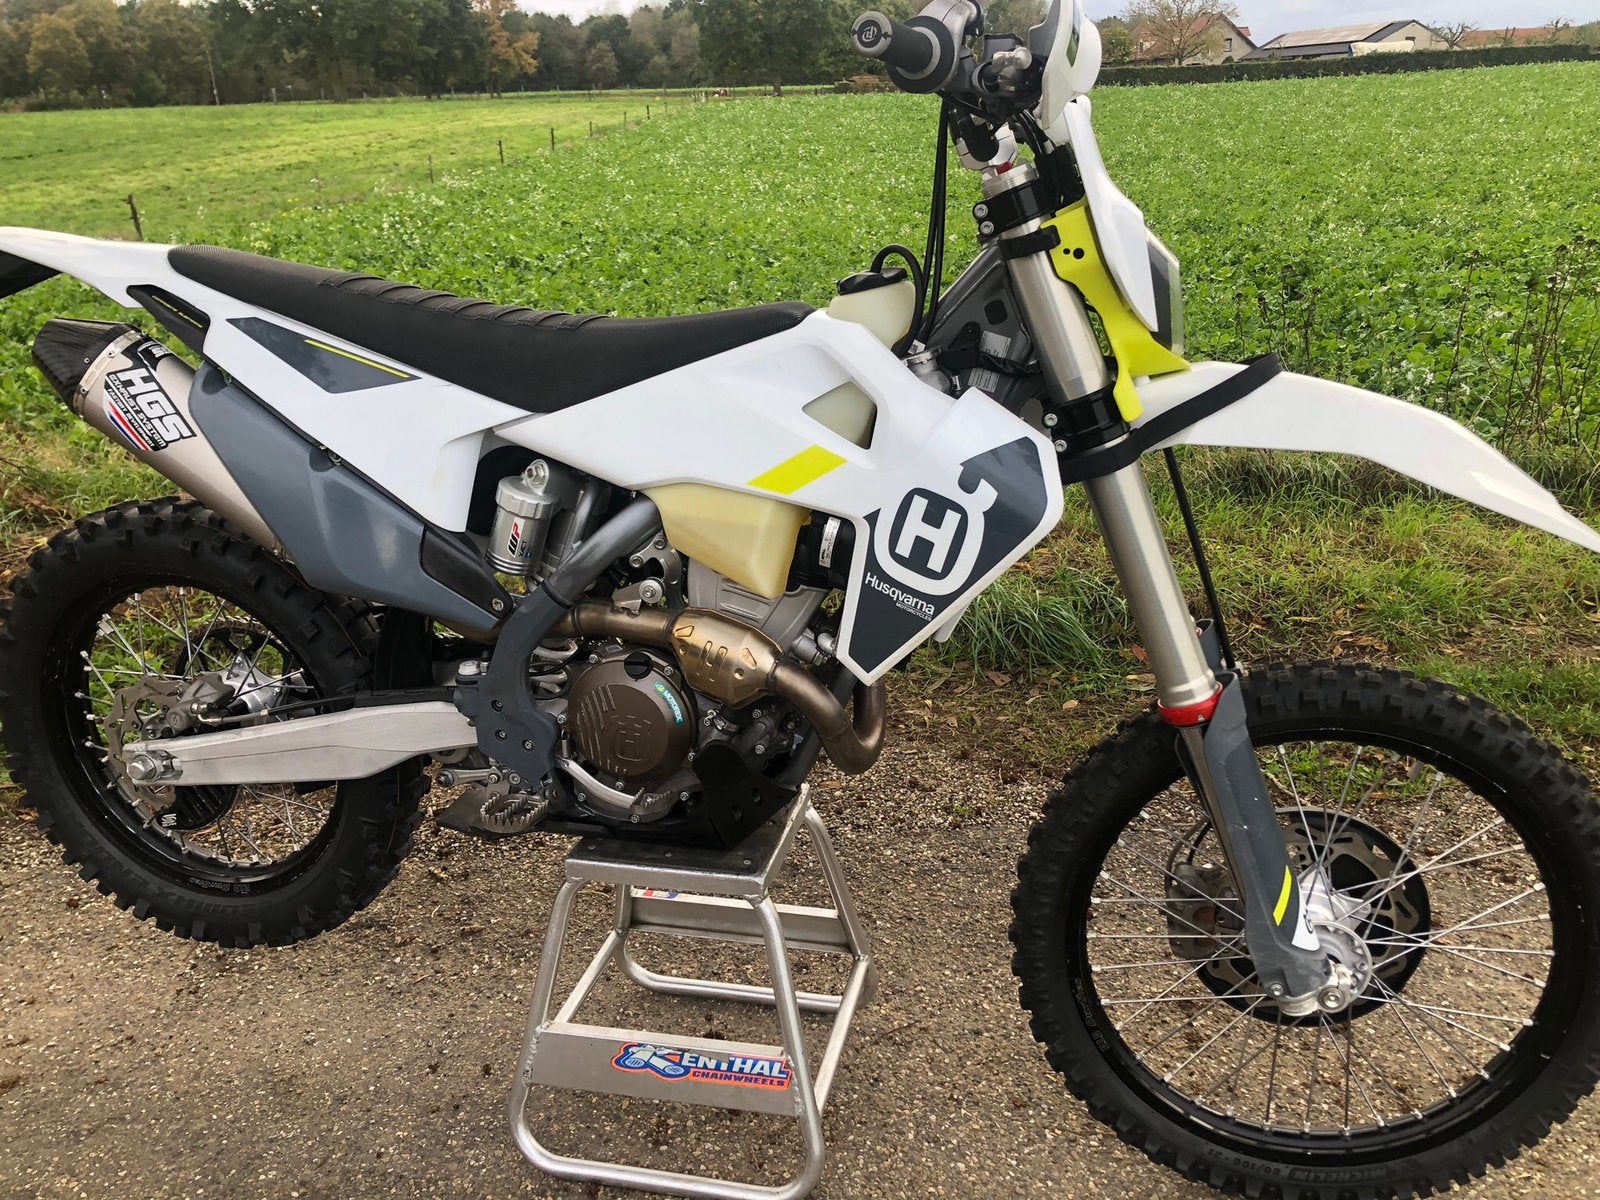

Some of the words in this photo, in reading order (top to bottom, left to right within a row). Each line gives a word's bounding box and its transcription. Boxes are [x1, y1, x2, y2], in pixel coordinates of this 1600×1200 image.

[109, 374, 141, 412] EXHAUST
[137, 412, 166, 447] SYSTEM
[116, 367, 193, 442] HGS
[864, 572, 936, 615] Husqvarna
[895, 602, 932, 621] MOTORCYCLES
[663, 690, 683, 721] MOTOREX
[692, 1070, 785, 1087] CHAINWHEELS
[1294, 1168, 1387, 1183] MICHELIN
